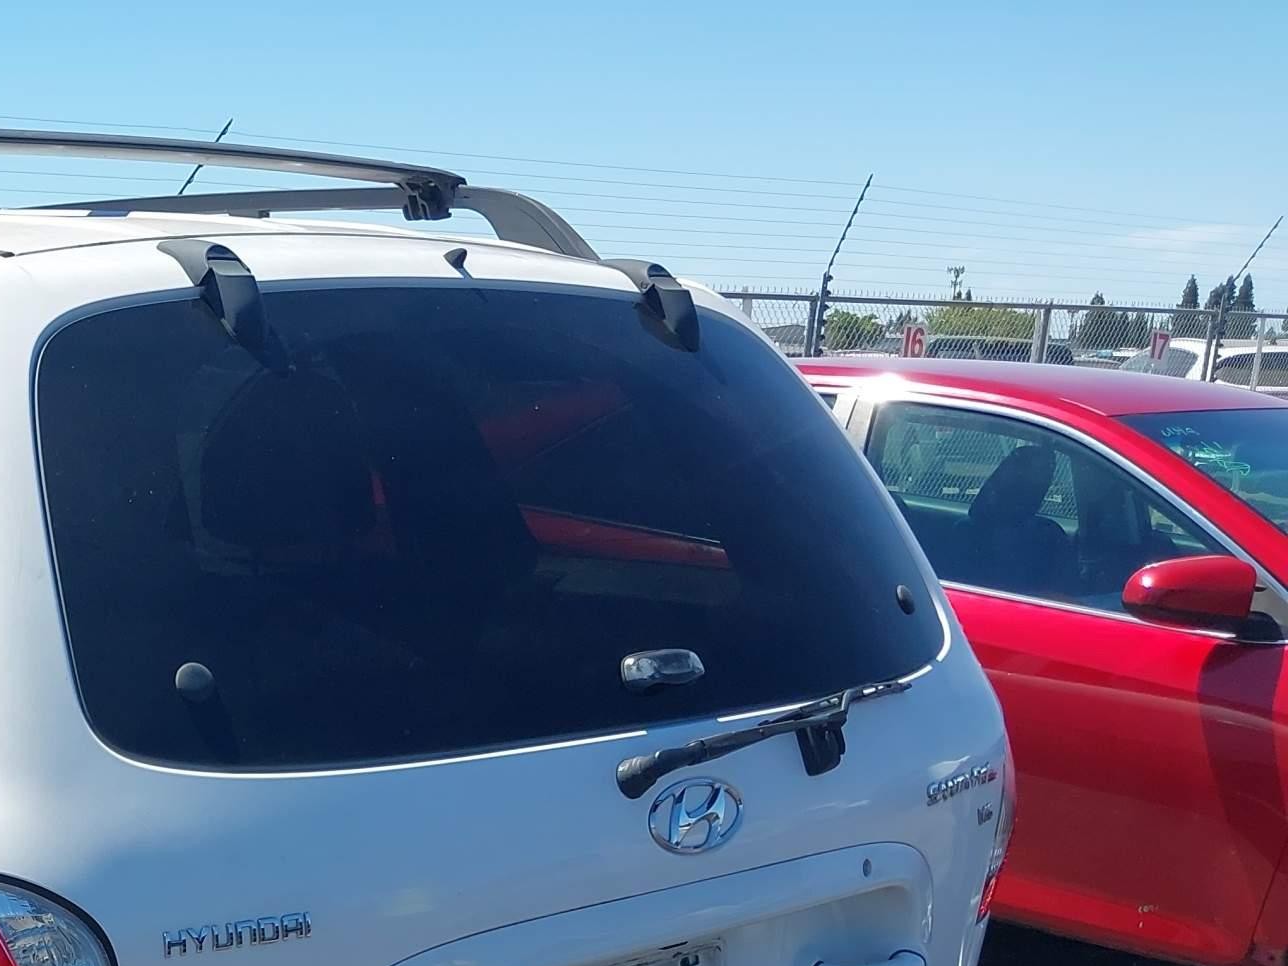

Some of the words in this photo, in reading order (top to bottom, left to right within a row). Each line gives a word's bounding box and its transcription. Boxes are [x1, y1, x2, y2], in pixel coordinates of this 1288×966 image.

[903, 326, 925, 358] 16
[1151, 332, 1169, 360] 17
[162, 911, 312, 959] HYUNDAI
